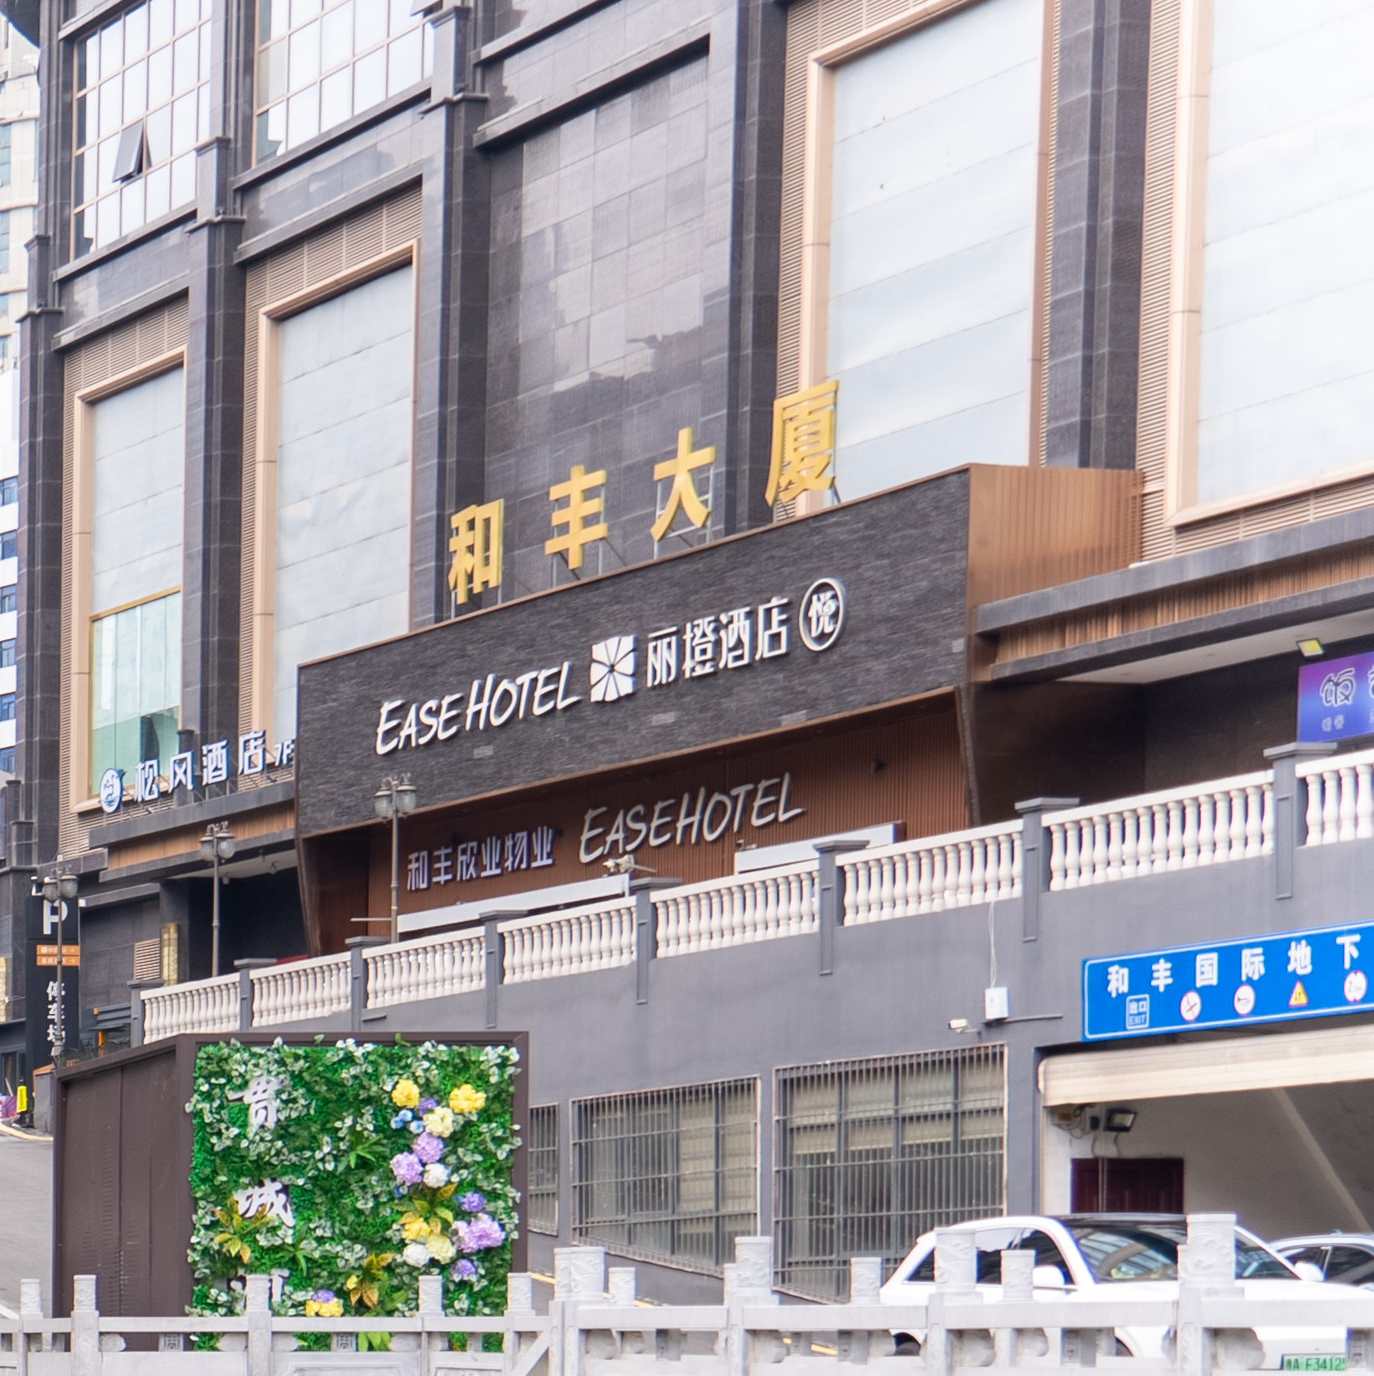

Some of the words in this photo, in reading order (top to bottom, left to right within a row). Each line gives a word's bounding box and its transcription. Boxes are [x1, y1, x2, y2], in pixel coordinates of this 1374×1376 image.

[448, 380, 839, 604] 和丰大厦
[646, 597, 792, 688] 丽橙酒店
[375, 692, 465, 756] EASE
[465, 661, 583, 732] HOTEL
[135, 730, 266, 802] 松风酒店
[406, 825, 555, 891] 和丰欣业物业
[43, 898, 69, 935] P
[1107, 934, 1361, 998] 和丰国际地下
[1128, 1001, 1147, 1014] 出口
[1128, 1014, 1146, 1026] EXIT
